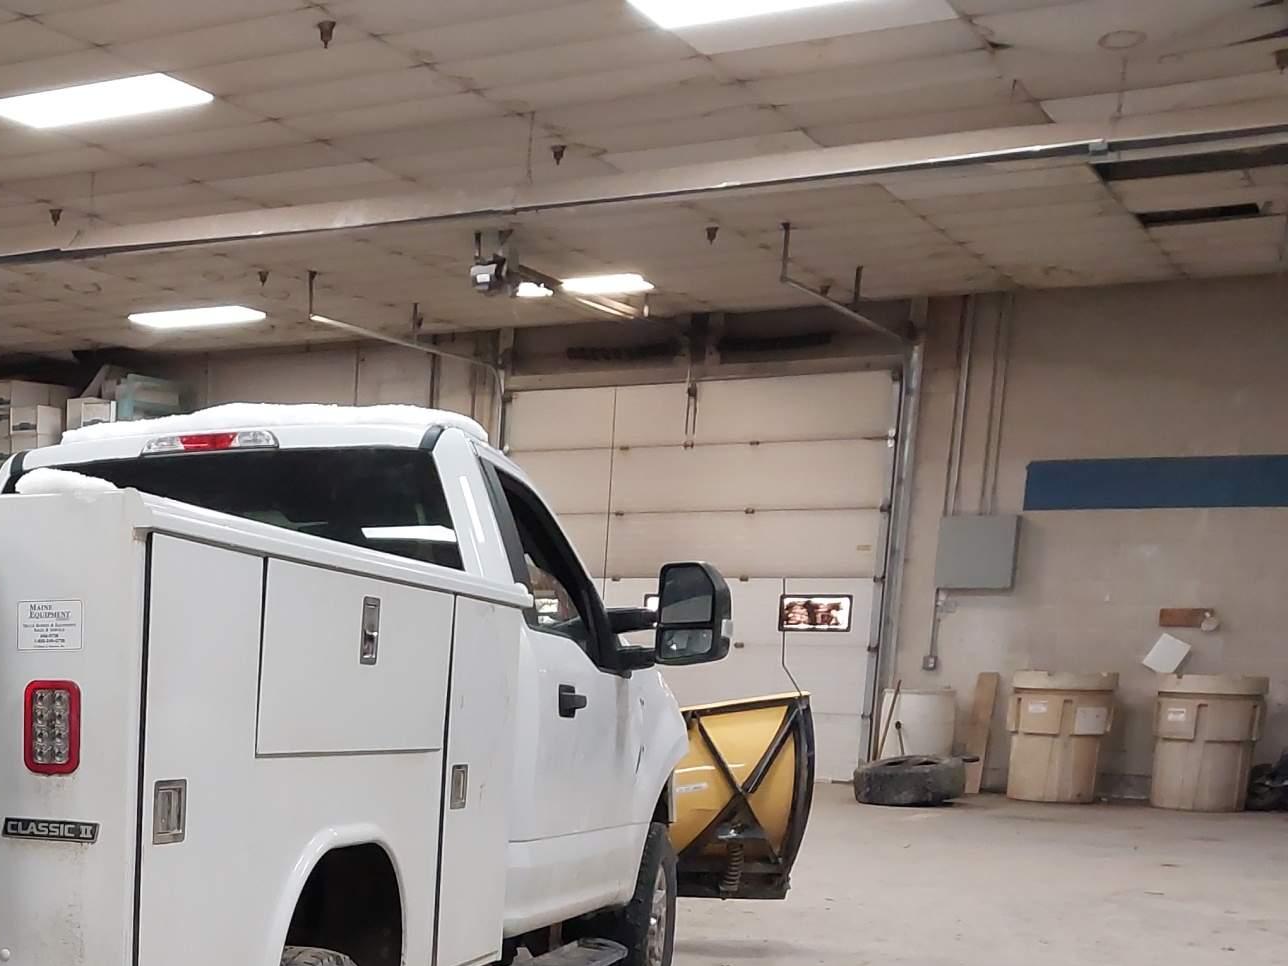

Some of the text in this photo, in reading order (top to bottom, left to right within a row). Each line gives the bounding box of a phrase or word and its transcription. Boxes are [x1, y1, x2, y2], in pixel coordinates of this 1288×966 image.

[29, 611, 71, 619] EQUIPMENT
[7, 821, 92, 838] CLASSIC II
